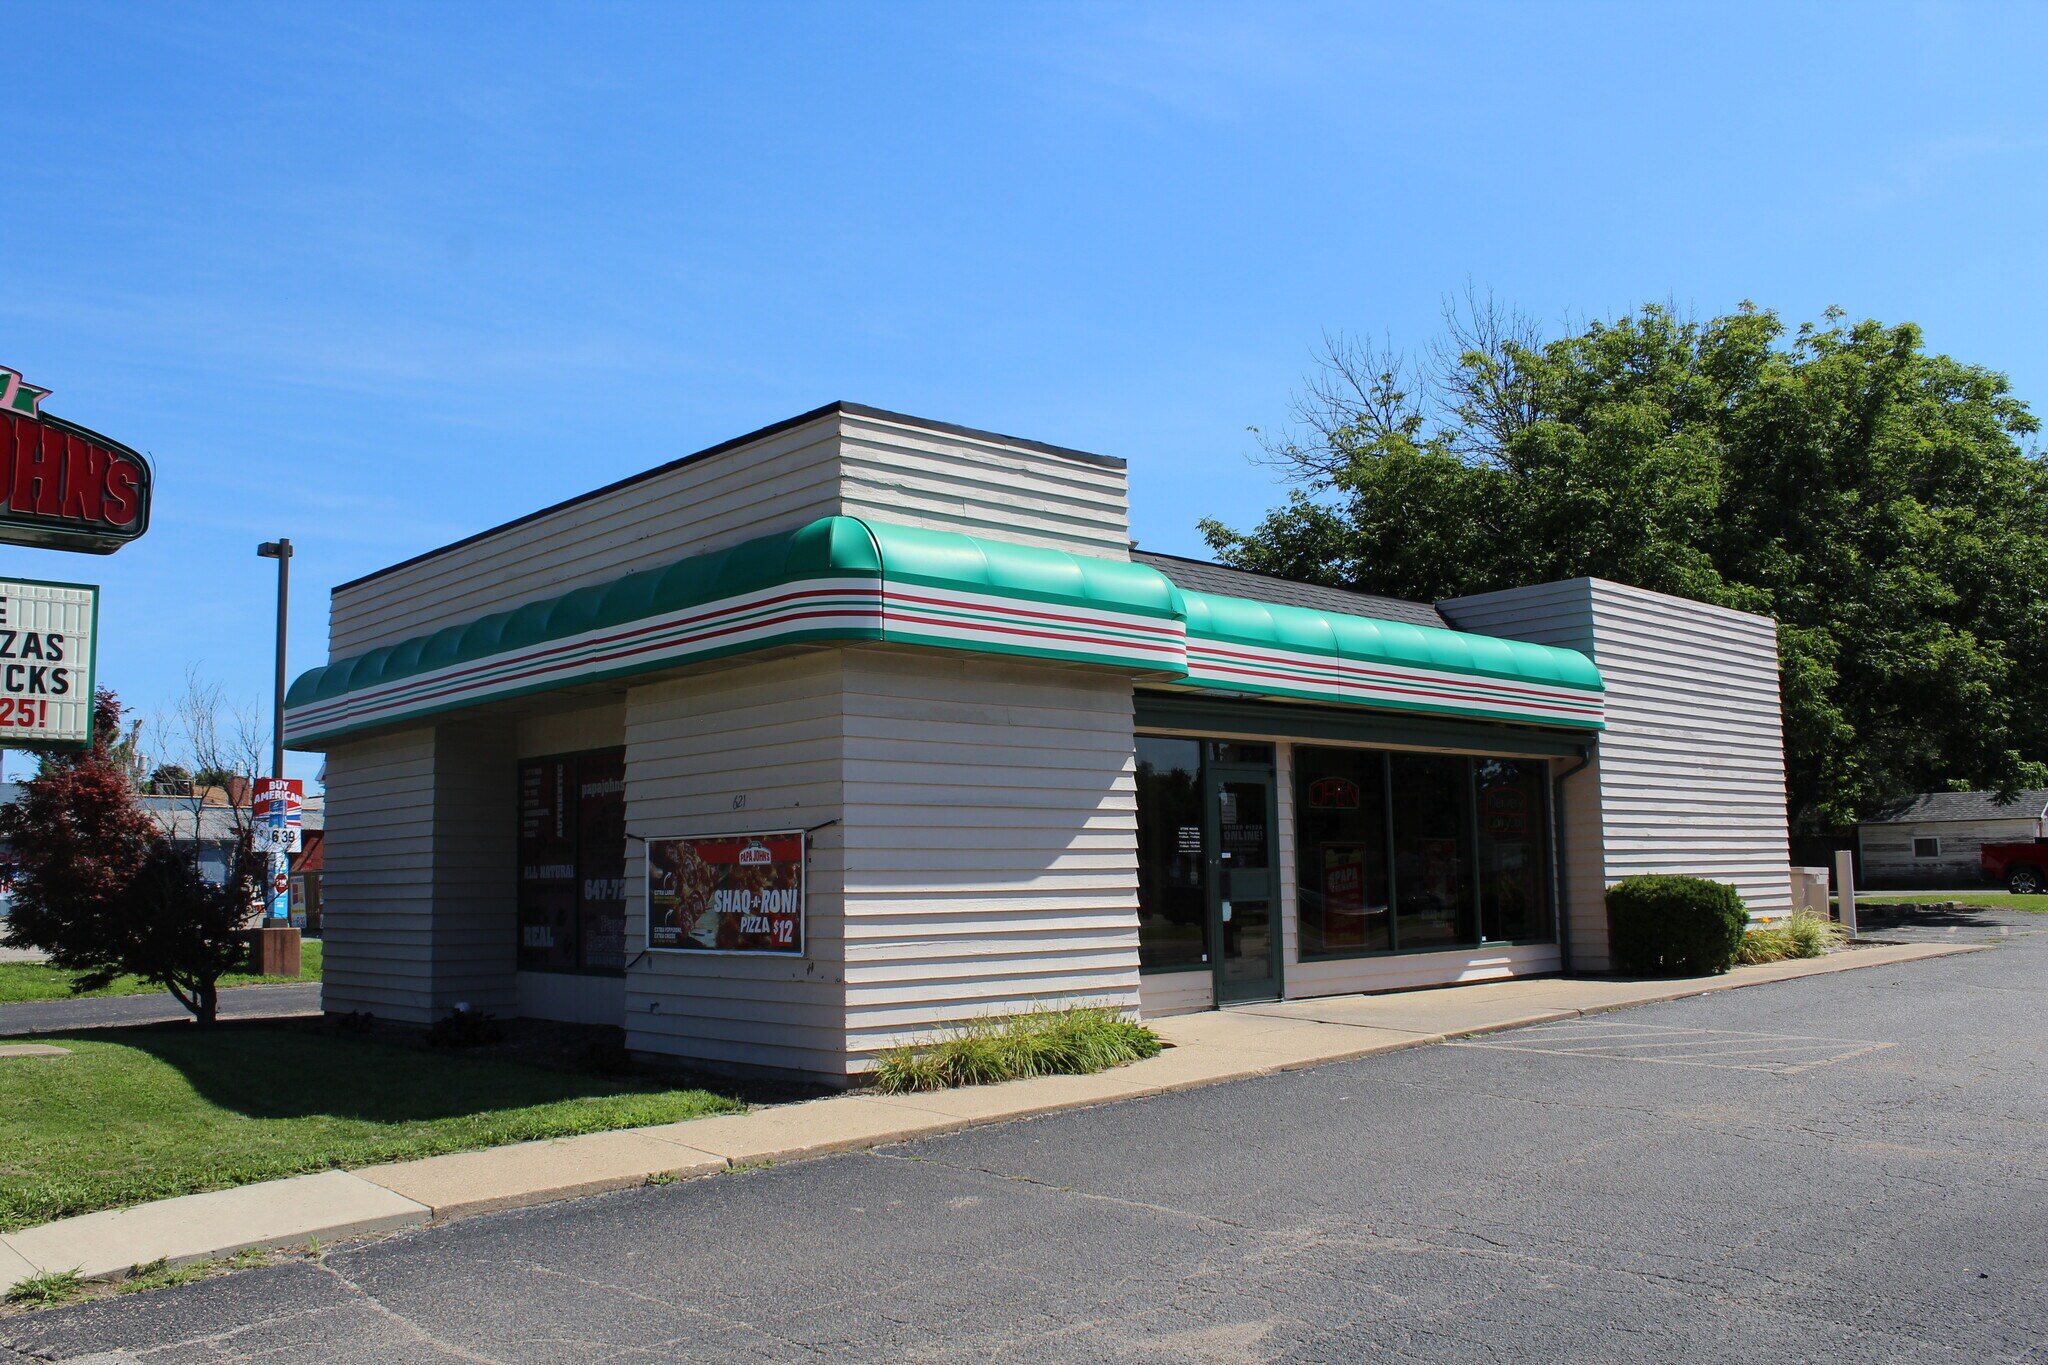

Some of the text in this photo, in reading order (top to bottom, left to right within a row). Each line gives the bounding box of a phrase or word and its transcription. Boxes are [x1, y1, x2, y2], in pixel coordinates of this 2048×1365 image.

[0, 698, 47, 727] 25!
[269, 781, 290, 791] BUY
[1311, 779, 1358, 807] OPEN
[254, 790, 302, 805] AMERICAN
[732, 794, 746, 810] 621
[1223, 831, 1264, 841] ONLINE!
[740, 850, 752, 863] PAPA
[523, 865, 538, 879] ALL
[740, 917, 770, 933] PIZZA
[773, 920, 793, 942] $12
[523, 926, 554, 947] REAL
